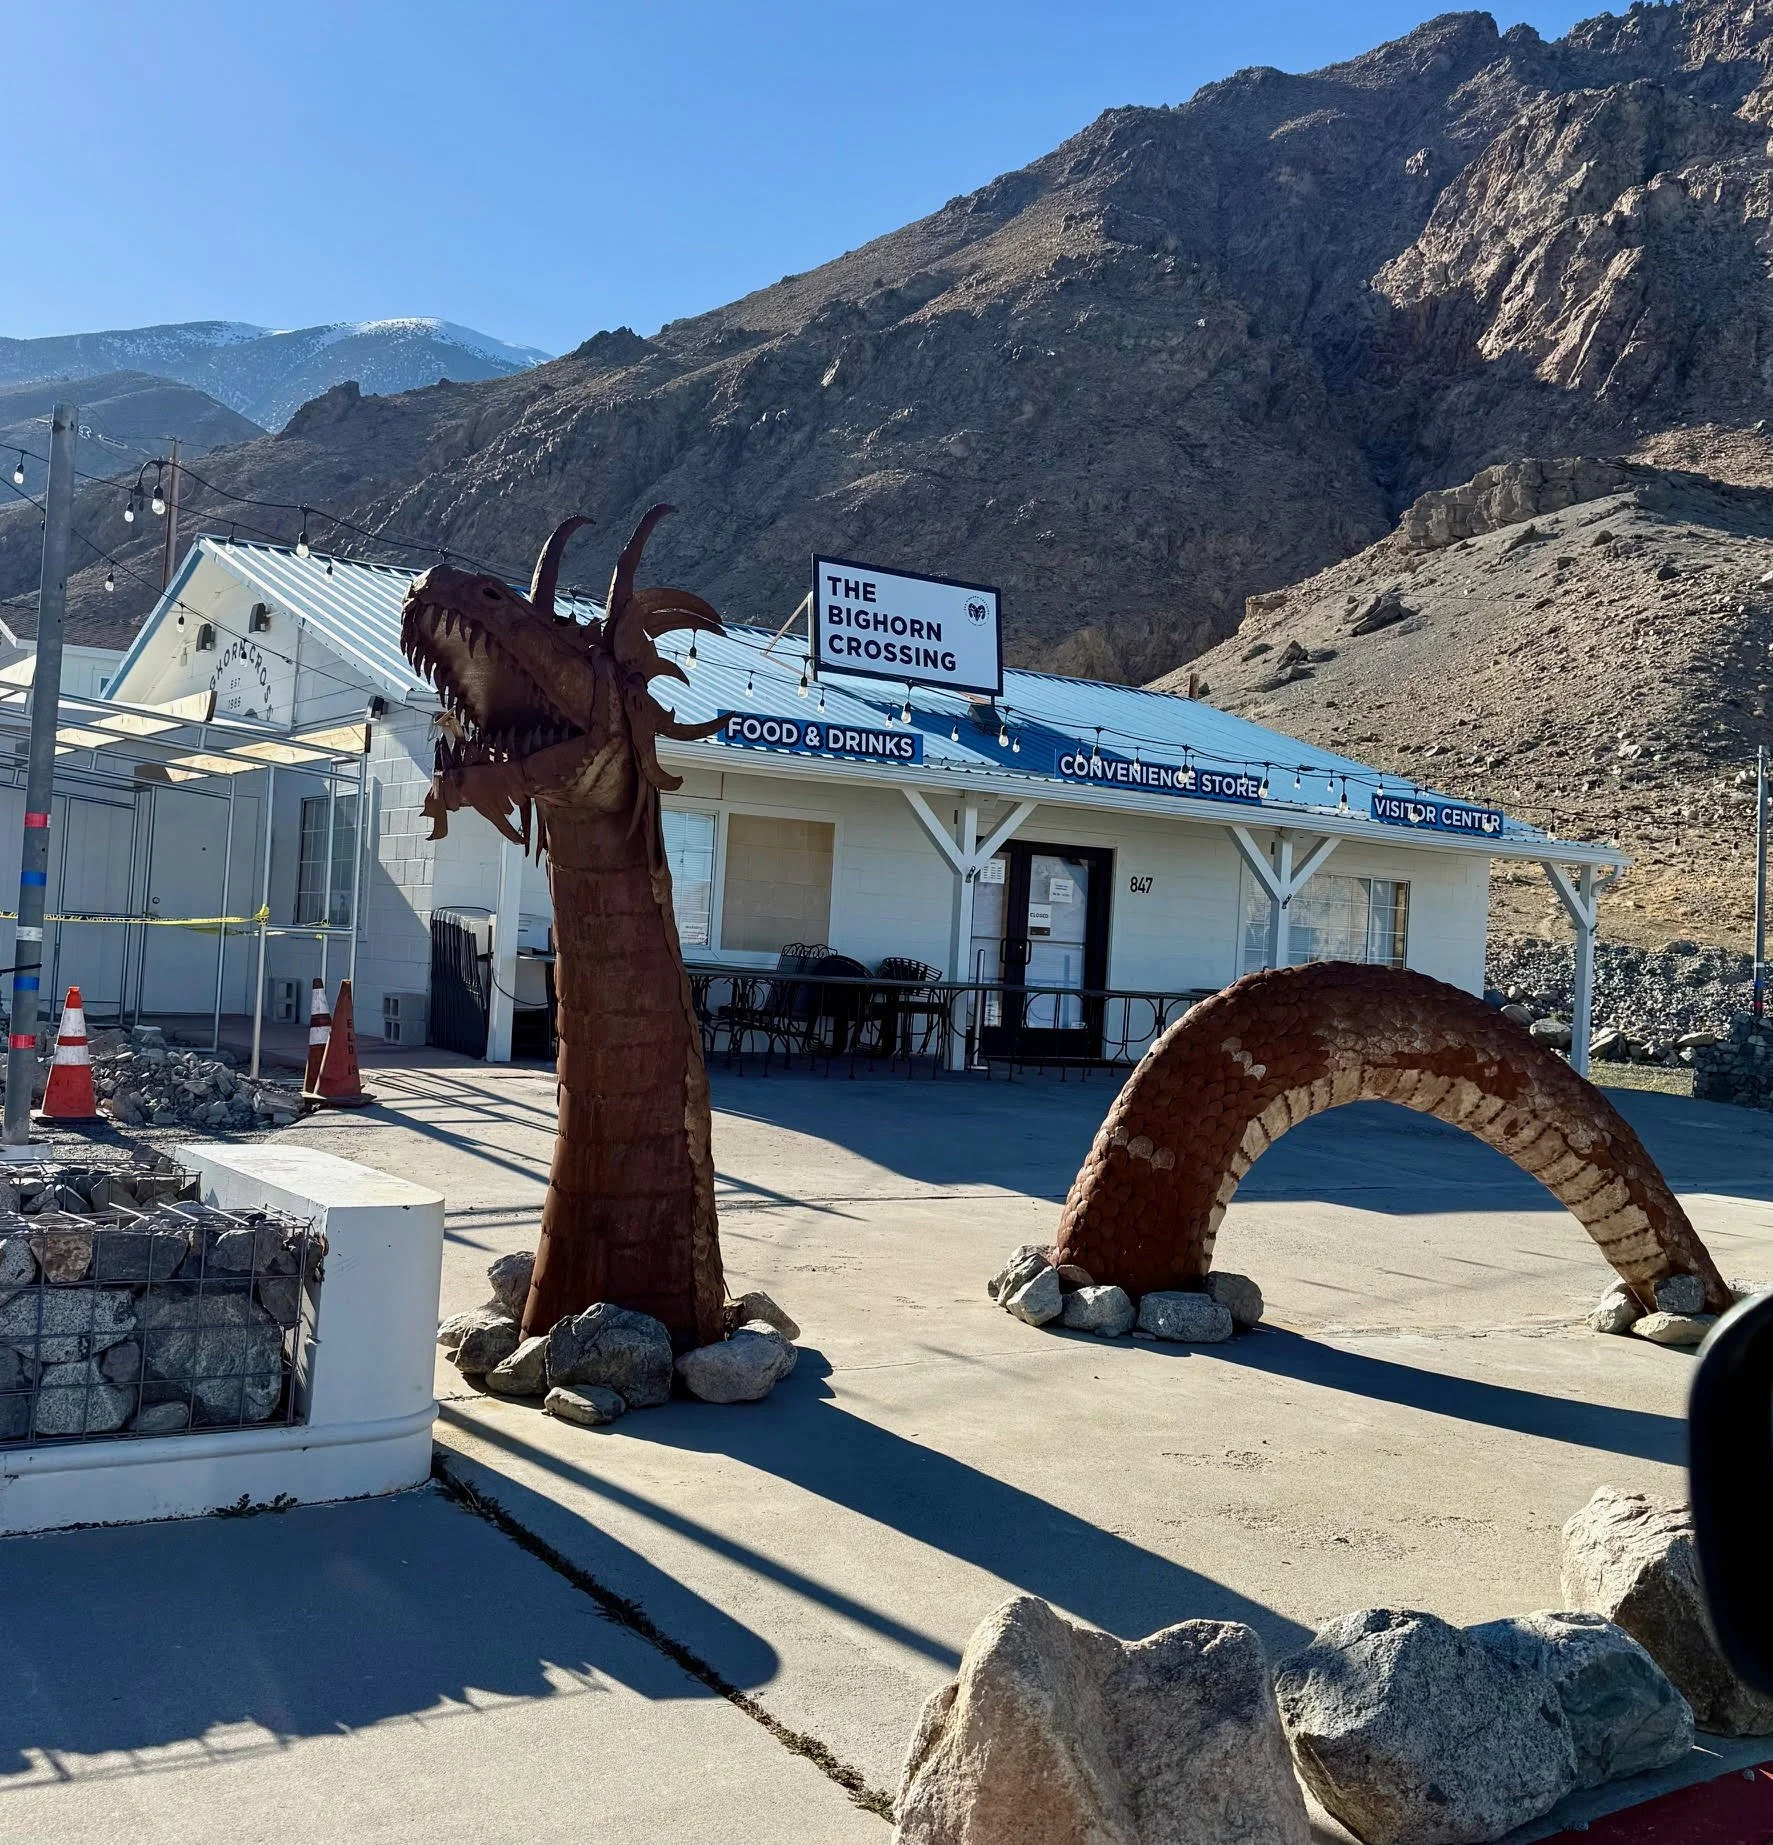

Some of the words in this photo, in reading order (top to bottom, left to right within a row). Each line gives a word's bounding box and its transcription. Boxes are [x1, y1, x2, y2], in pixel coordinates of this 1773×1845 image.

[827, 576, 876, 603] THE
[828, 604, 942, 643] BIGHORN
[828, 634, 956, 672] CROSSING
[728, 717, 798, 743] FOOD
[805, 726, 820, 747] &
[828, 729, 913, 757] DRINKS
[1061, 756, 1196, 790] CONVENIENCE
[1202, 774, 1258, 798] STORE
[1130, 876, 1153, 894] 847
